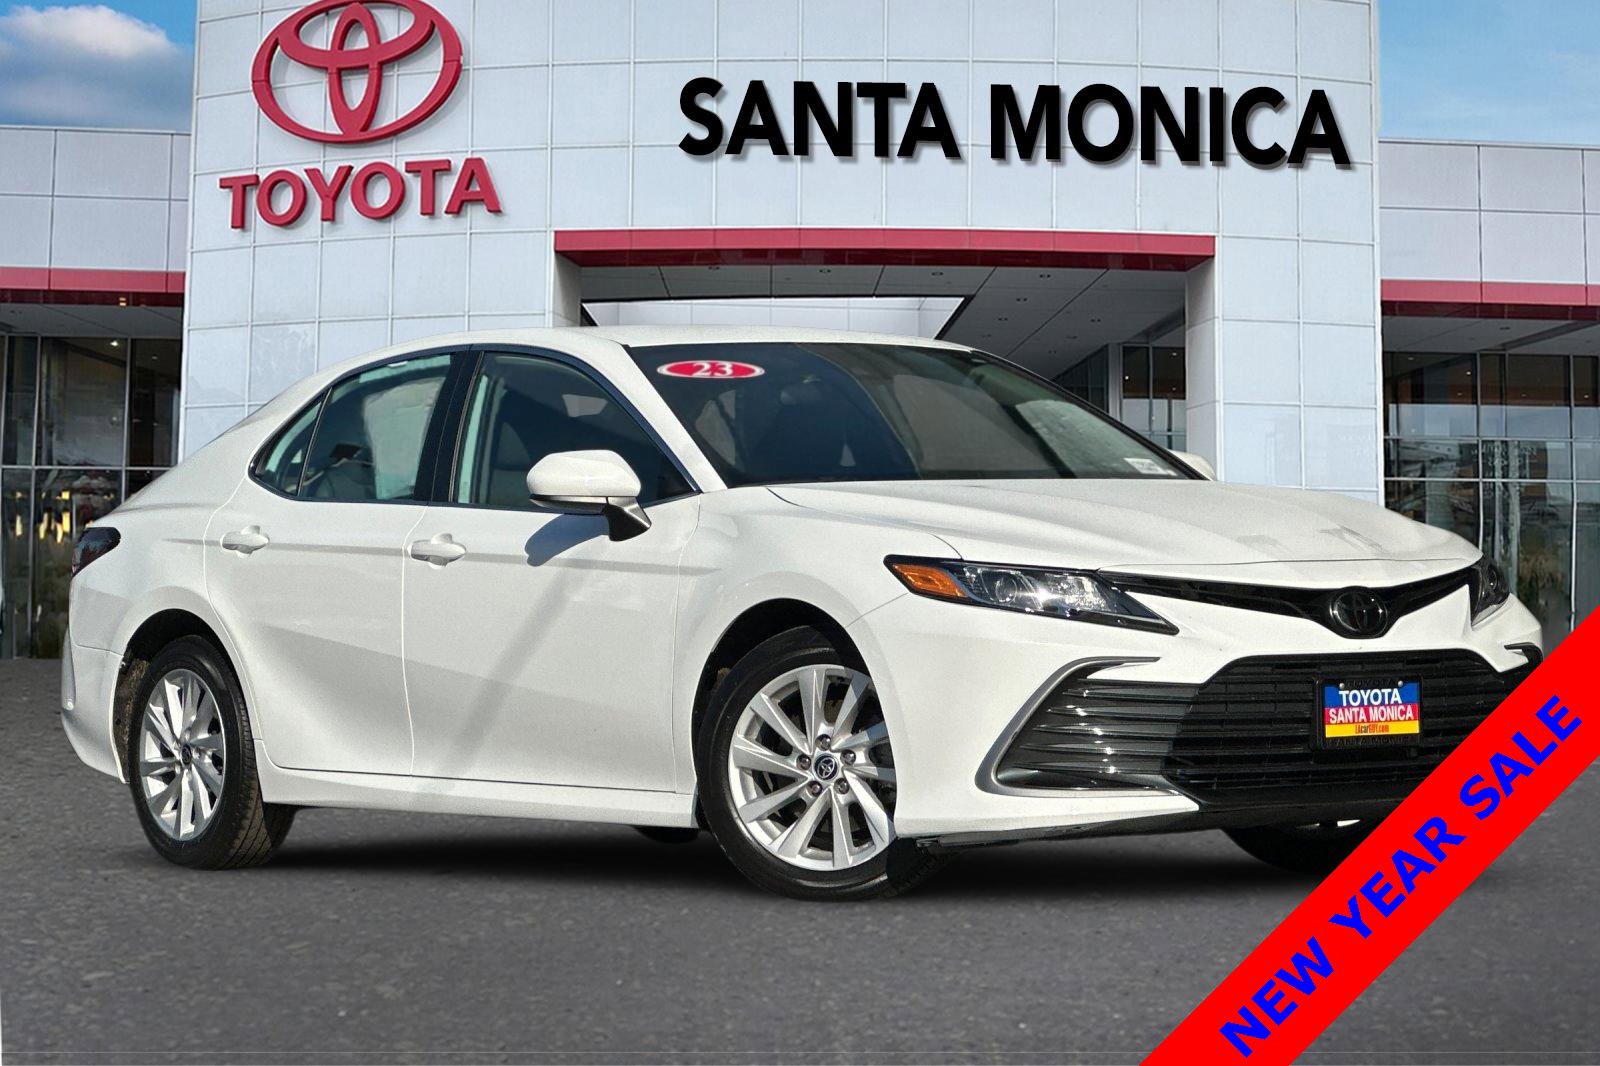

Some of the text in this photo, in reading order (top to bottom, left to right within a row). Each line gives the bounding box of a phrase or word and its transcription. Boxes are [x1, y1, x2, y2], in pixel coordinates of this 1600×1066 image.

[678, 77, 1351, 166] SANTA MONICA
[219, 156, 502, 229] TOYOTA
[692, 361, 734, 377] 23
[1338, 688, 1402, 706] TOYOTA
[1328, 704, 1414, 724] SANTA MONICA
